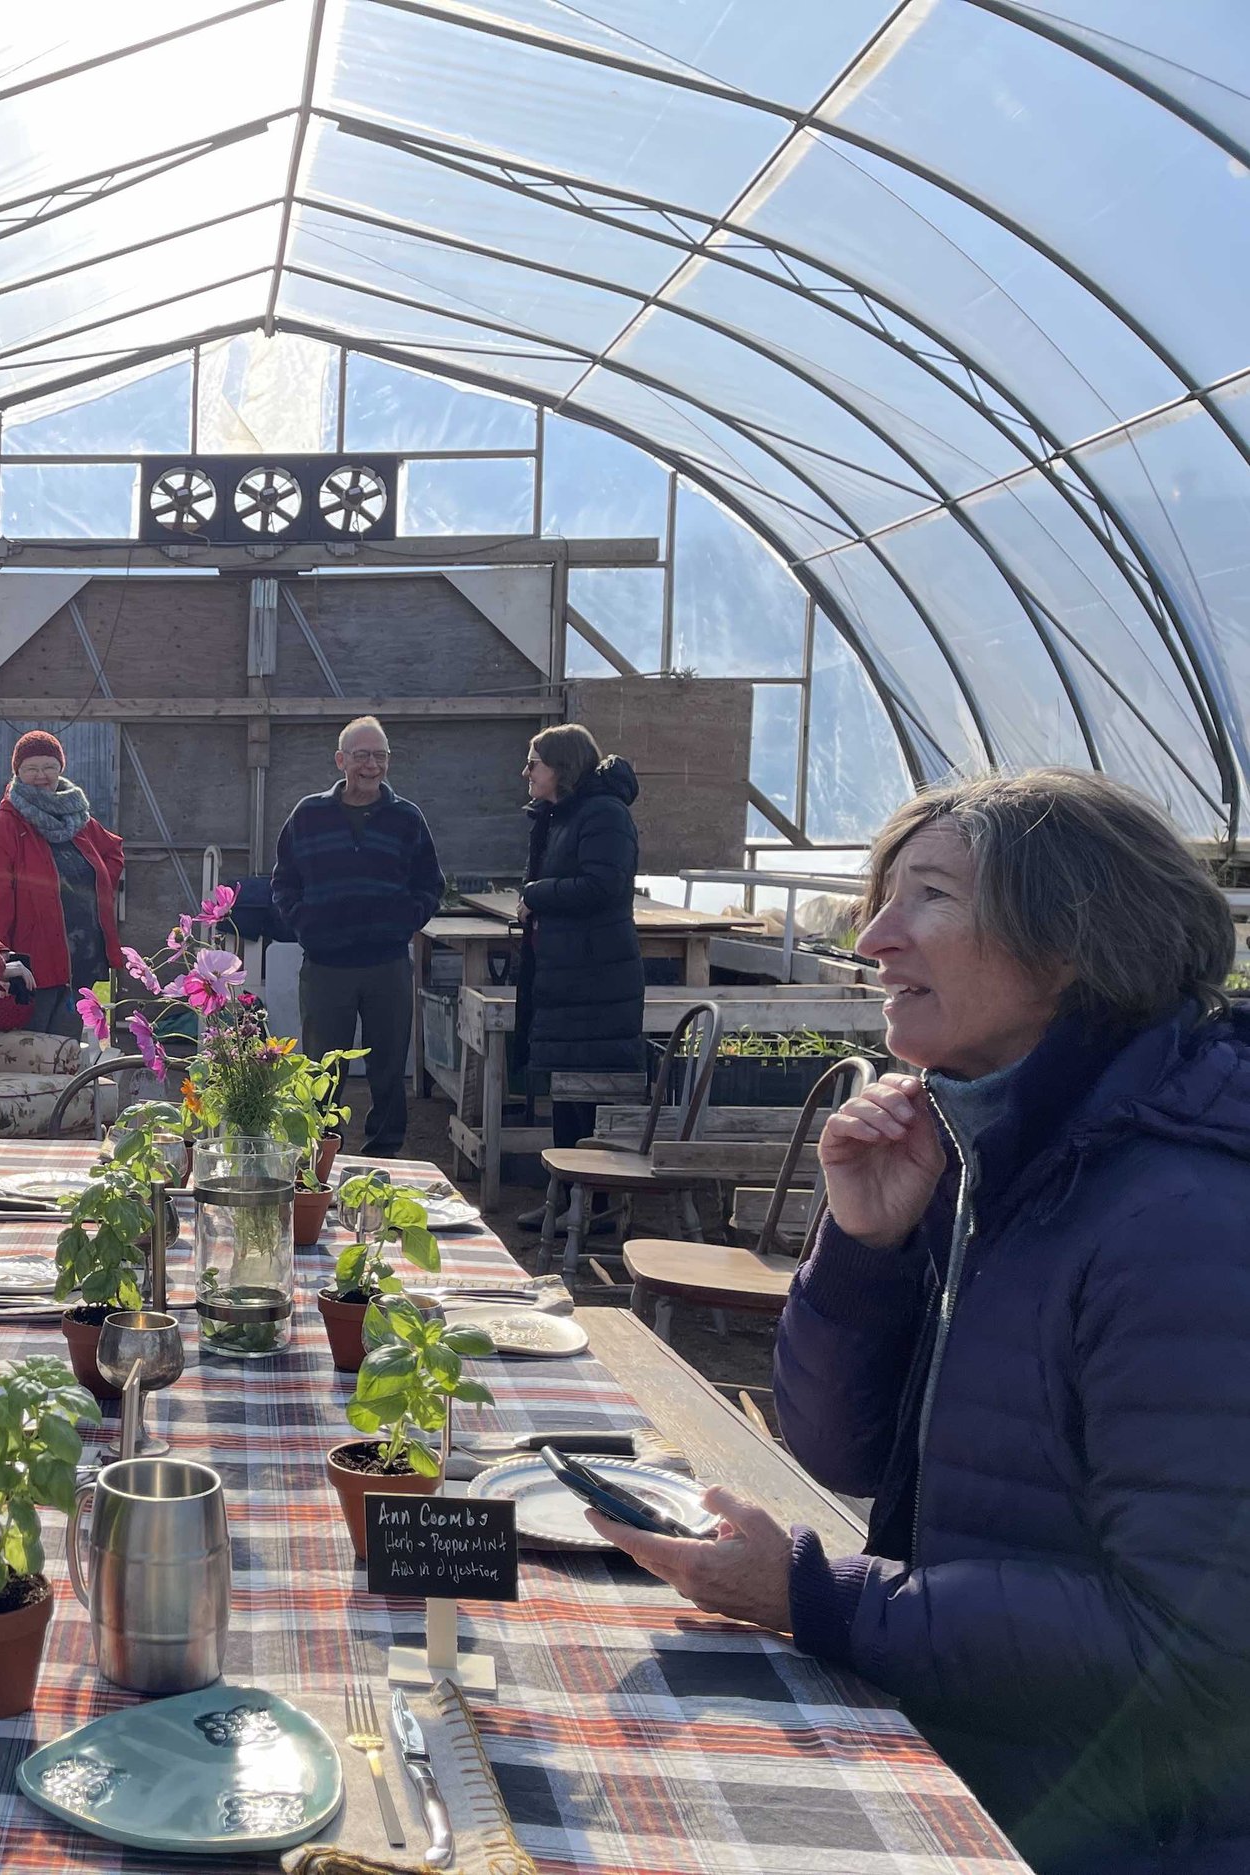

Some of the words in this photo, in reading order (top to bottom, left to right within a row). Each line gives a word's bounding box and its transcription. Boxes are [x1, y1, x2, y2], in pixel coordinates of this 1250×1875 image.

[378, 1501, 411, 1526] Ann
[384, 1530, 414, 1554] Herb
[419, 1561, 430, 1577] in
